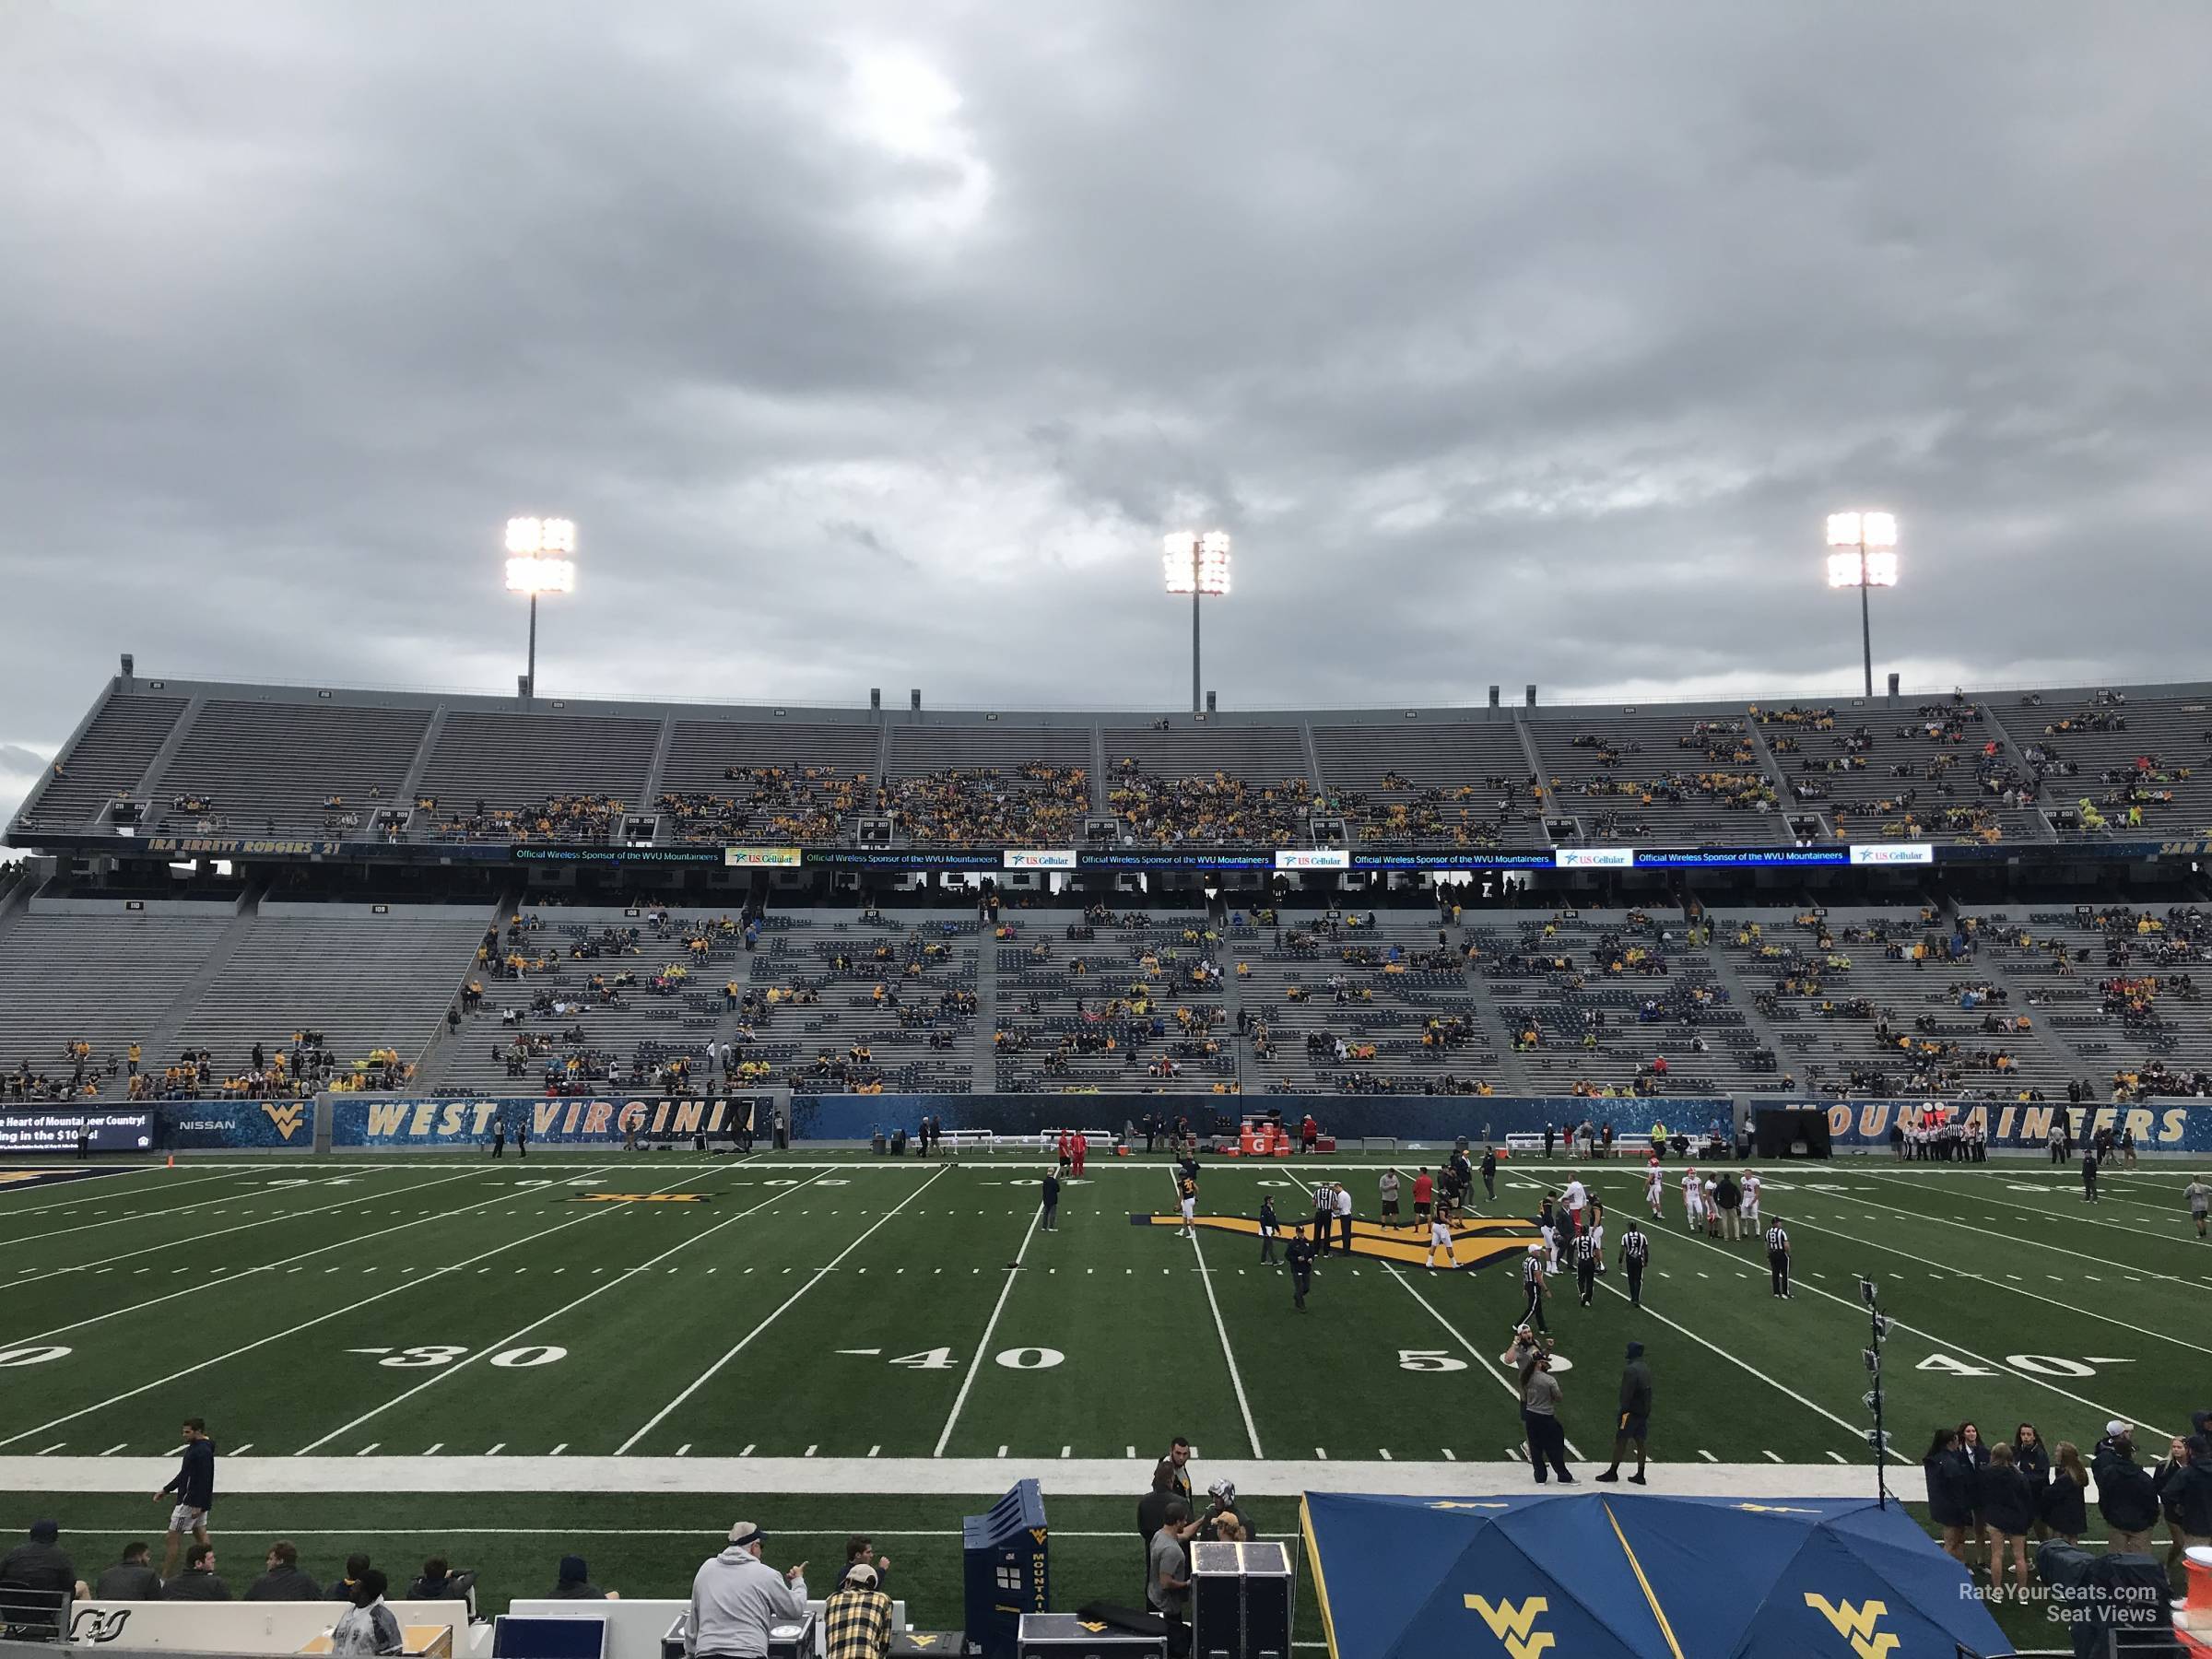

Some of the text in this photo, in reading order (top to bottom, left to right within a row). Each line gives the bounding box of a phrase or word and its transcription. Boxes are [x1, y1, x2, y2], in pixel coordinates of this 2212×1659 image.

[147, 838, 340, 854] IRA ERRETT RODGERS 21
[516, 850, 546, 858] Official
[547, 850, 581, 858] Wireless
[582, 851, 615, 860] Sponsor
[617, 851, 626, 860] of
[641, 852, 663, 860] WVU
[664, 852, 719, 861] Mountaineers
[762, 854, 793, 863] Cellular
[806, 853, 997, 864] Official Wireless Sponsor of the WVU Mountaineers
[1040, 856, 1068, 865] Cellular
[1082, 855, 1269, 865] Official Wireless Sponsor of the WVU Mountaineers
[1355, 855, 1382, 864] Official
[1382, 855, 1415, 864] Wireless
[1417, 855, 1448, 865] Sponsor
[1450, 855, 1458, 864] of
[1459, 855, 1472, 864] the
[1593, 855, 1624, 864] Cellular
[1639, 853, 1666, 862] Official
[1668, 853, 1701, 862] Wireless
[1703, 853, 1736, 862] Sponsor
[1738, 853, 1747, 861] of
[1748, 853, 1762, 861] the
[1786, 852, 1842, 860] Mountaineers
[1889, 852, 1923, 860] Cellular
[6, 1117, 32, 1127] Heart
[34, 1116, 45, 1127] of
[46, 1116, 104, 1126] Mountaieer
[106, 1115, 146, 1127] Country!
[368, 1102, 498, 1136] WEST
[1785, 1104, 2187, 1142] OUNAINEERS
[180, 1120, 236, 1130] NISSAN
[24, 1131, 31, 1141] in
[34, 1130, 54, 1141] the
[57, 1130, 98, 1141] $10s!
[1253, 1139, 1265, 1152] G
[1630, 1236, 1639, 1248] F
[1769, 1232, 1777, 1243] B
[1581, 1241, 1589, 1252] S
[377, 1345, 568, 1368] 30
[888, 1346, 1065, 1370] 40
[1914, 1353, 2098, 1377] 40
